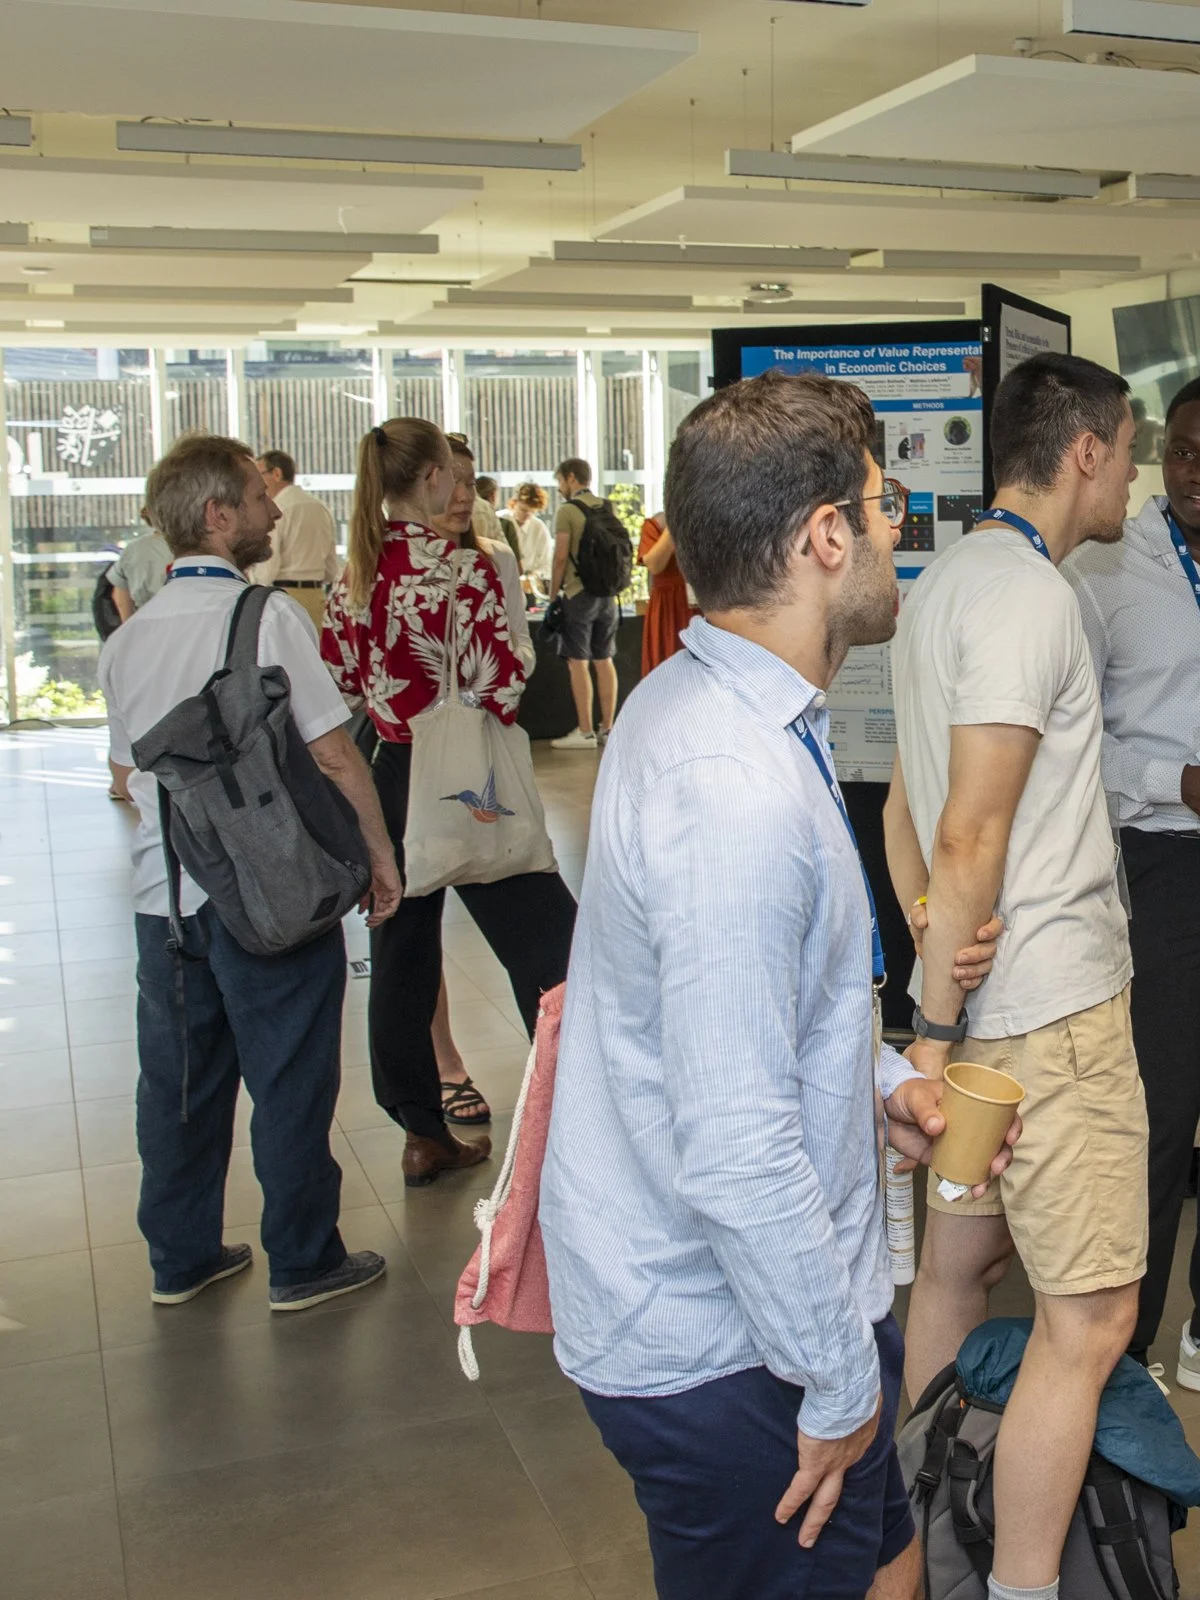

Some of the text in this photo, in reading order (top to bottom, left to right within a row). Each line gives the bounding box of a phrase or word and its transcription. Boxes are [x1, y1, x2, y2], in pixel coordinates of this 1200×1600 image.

[773, 349, 794, 359] The
[796, 349, 860, 359] Importance
[862, 347, 875, 357] of
[878, 347, 909, 356] Value
[825, 361, 946, 373] in Economic Choices
[912, 402, 944, 410] METHODS
